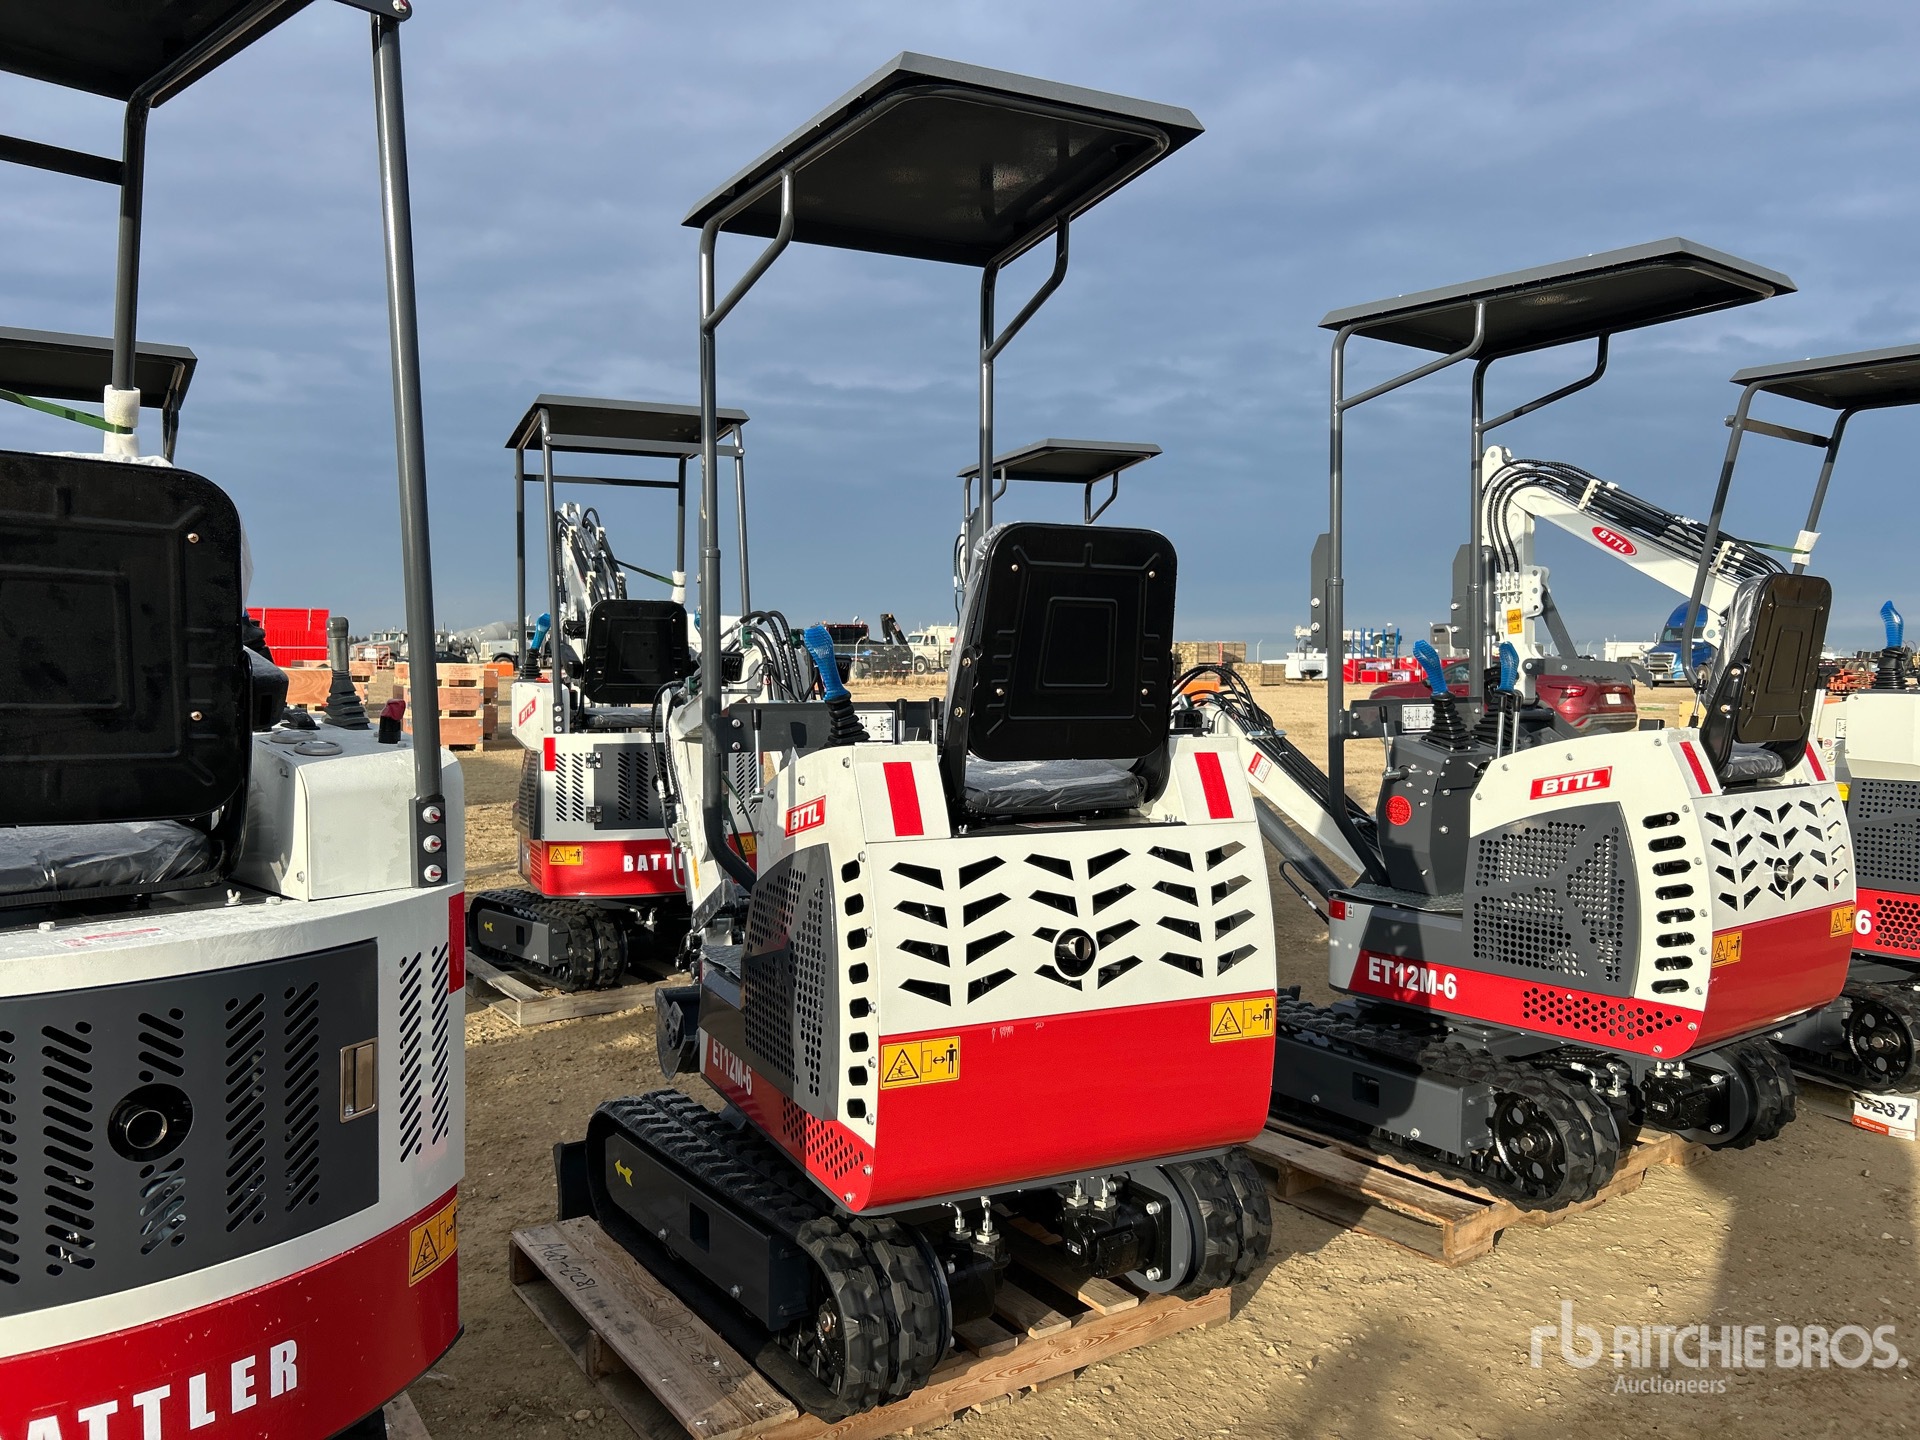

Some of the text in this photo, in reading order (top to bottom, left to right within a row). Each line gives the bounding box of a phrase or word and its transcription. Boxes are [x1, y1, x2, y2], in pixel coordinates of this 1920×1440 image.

[1598, 529, 1627, 553] BTTL
[1540, 772, 1601, 795] BTTL
[790, 803, 821, 831] BTTL
[1855, 909, 1872, 935] 6
[1368, 956, 1457, 1000] ET12M-6
[712, 1037, 752, 1096] ET12M-6
